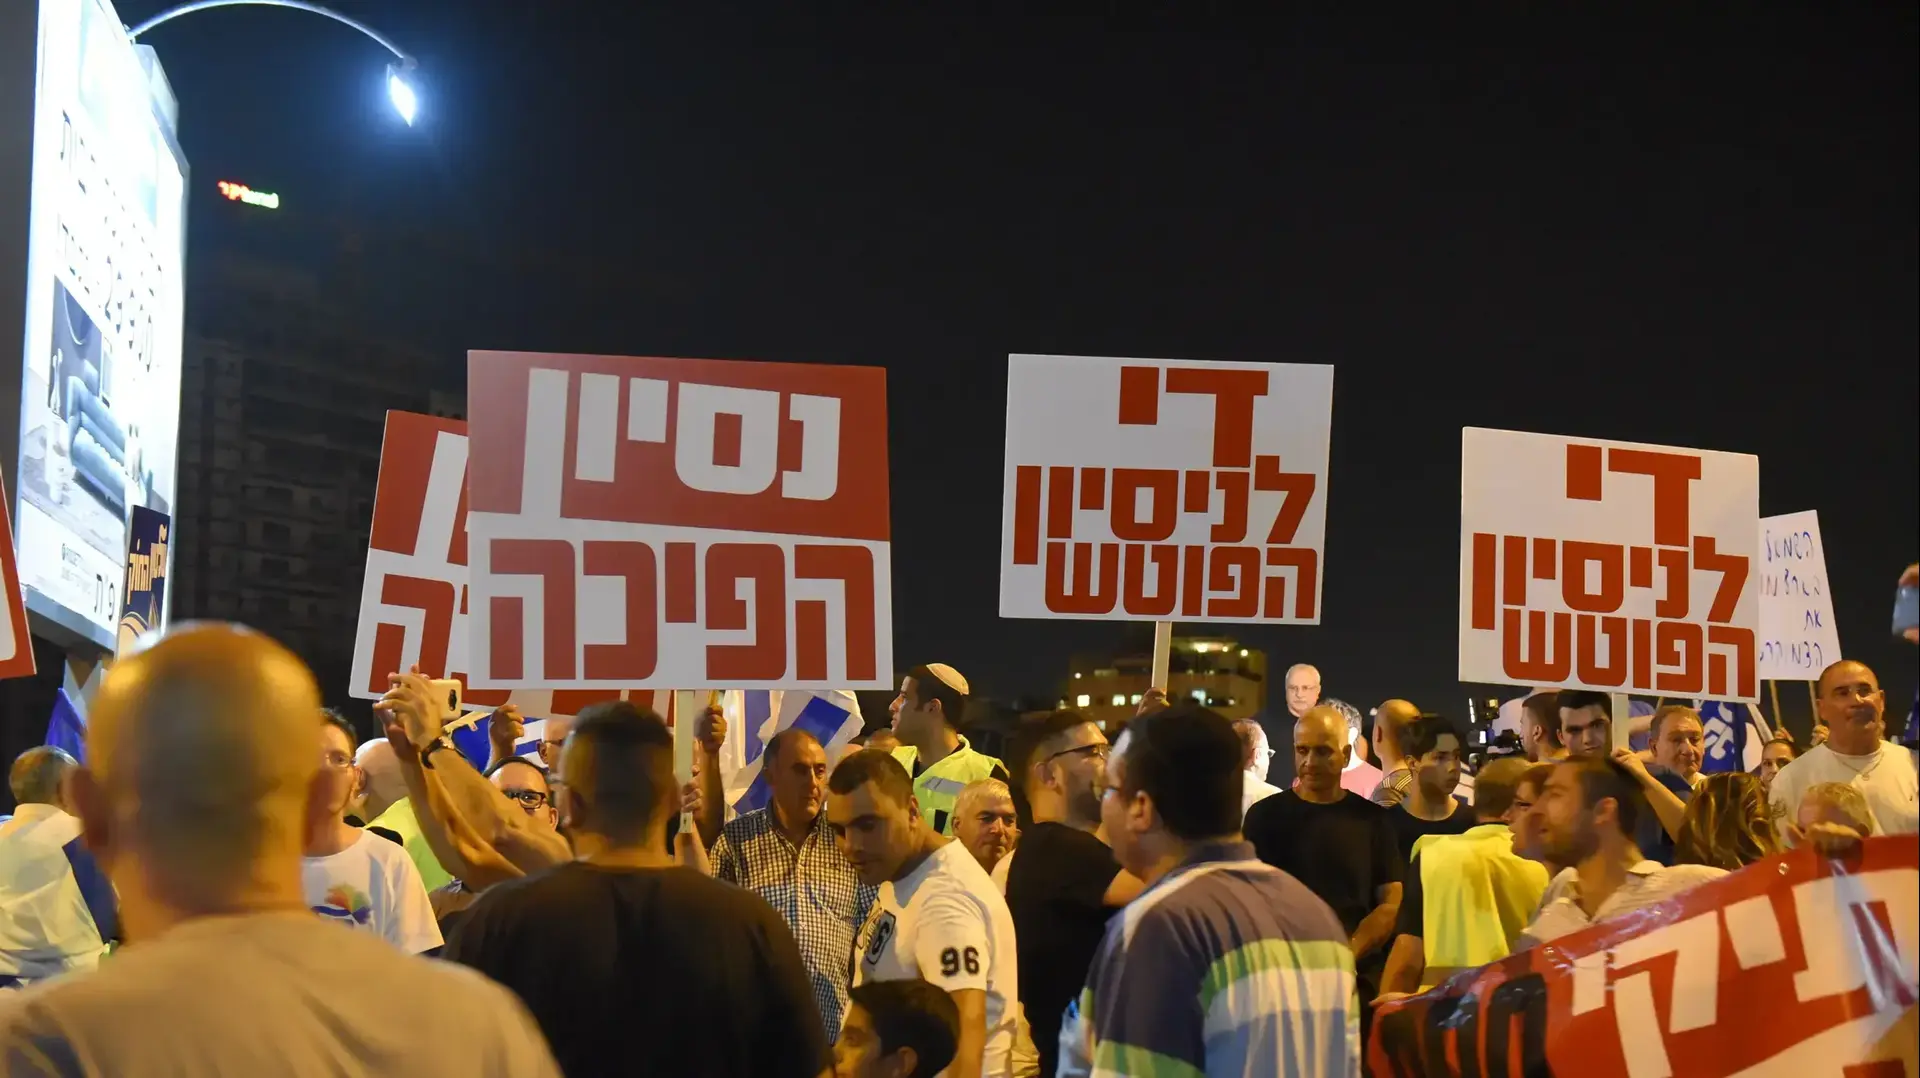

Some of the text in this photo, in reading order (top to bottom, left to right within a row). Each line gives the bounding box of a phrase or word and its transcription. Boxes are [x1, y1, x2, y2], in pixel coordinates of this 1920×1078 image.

[520, 367, 841, 517] נסיון
[1119, 366, 1269, 467] די
[1013, 455, 1316, 565] לניסיון
[1566, 443, 1702, 546] די
[490, 539, 876, 681] הפיכה
[1045, 541, 1317, 619] הפוטש
[1471, 532, 1750, 631] לניסיון
[1804, 608, 1823, 631] את
[1502, 607, 1757, 698] הפוטש
[941, 946, 980, 977] 96
